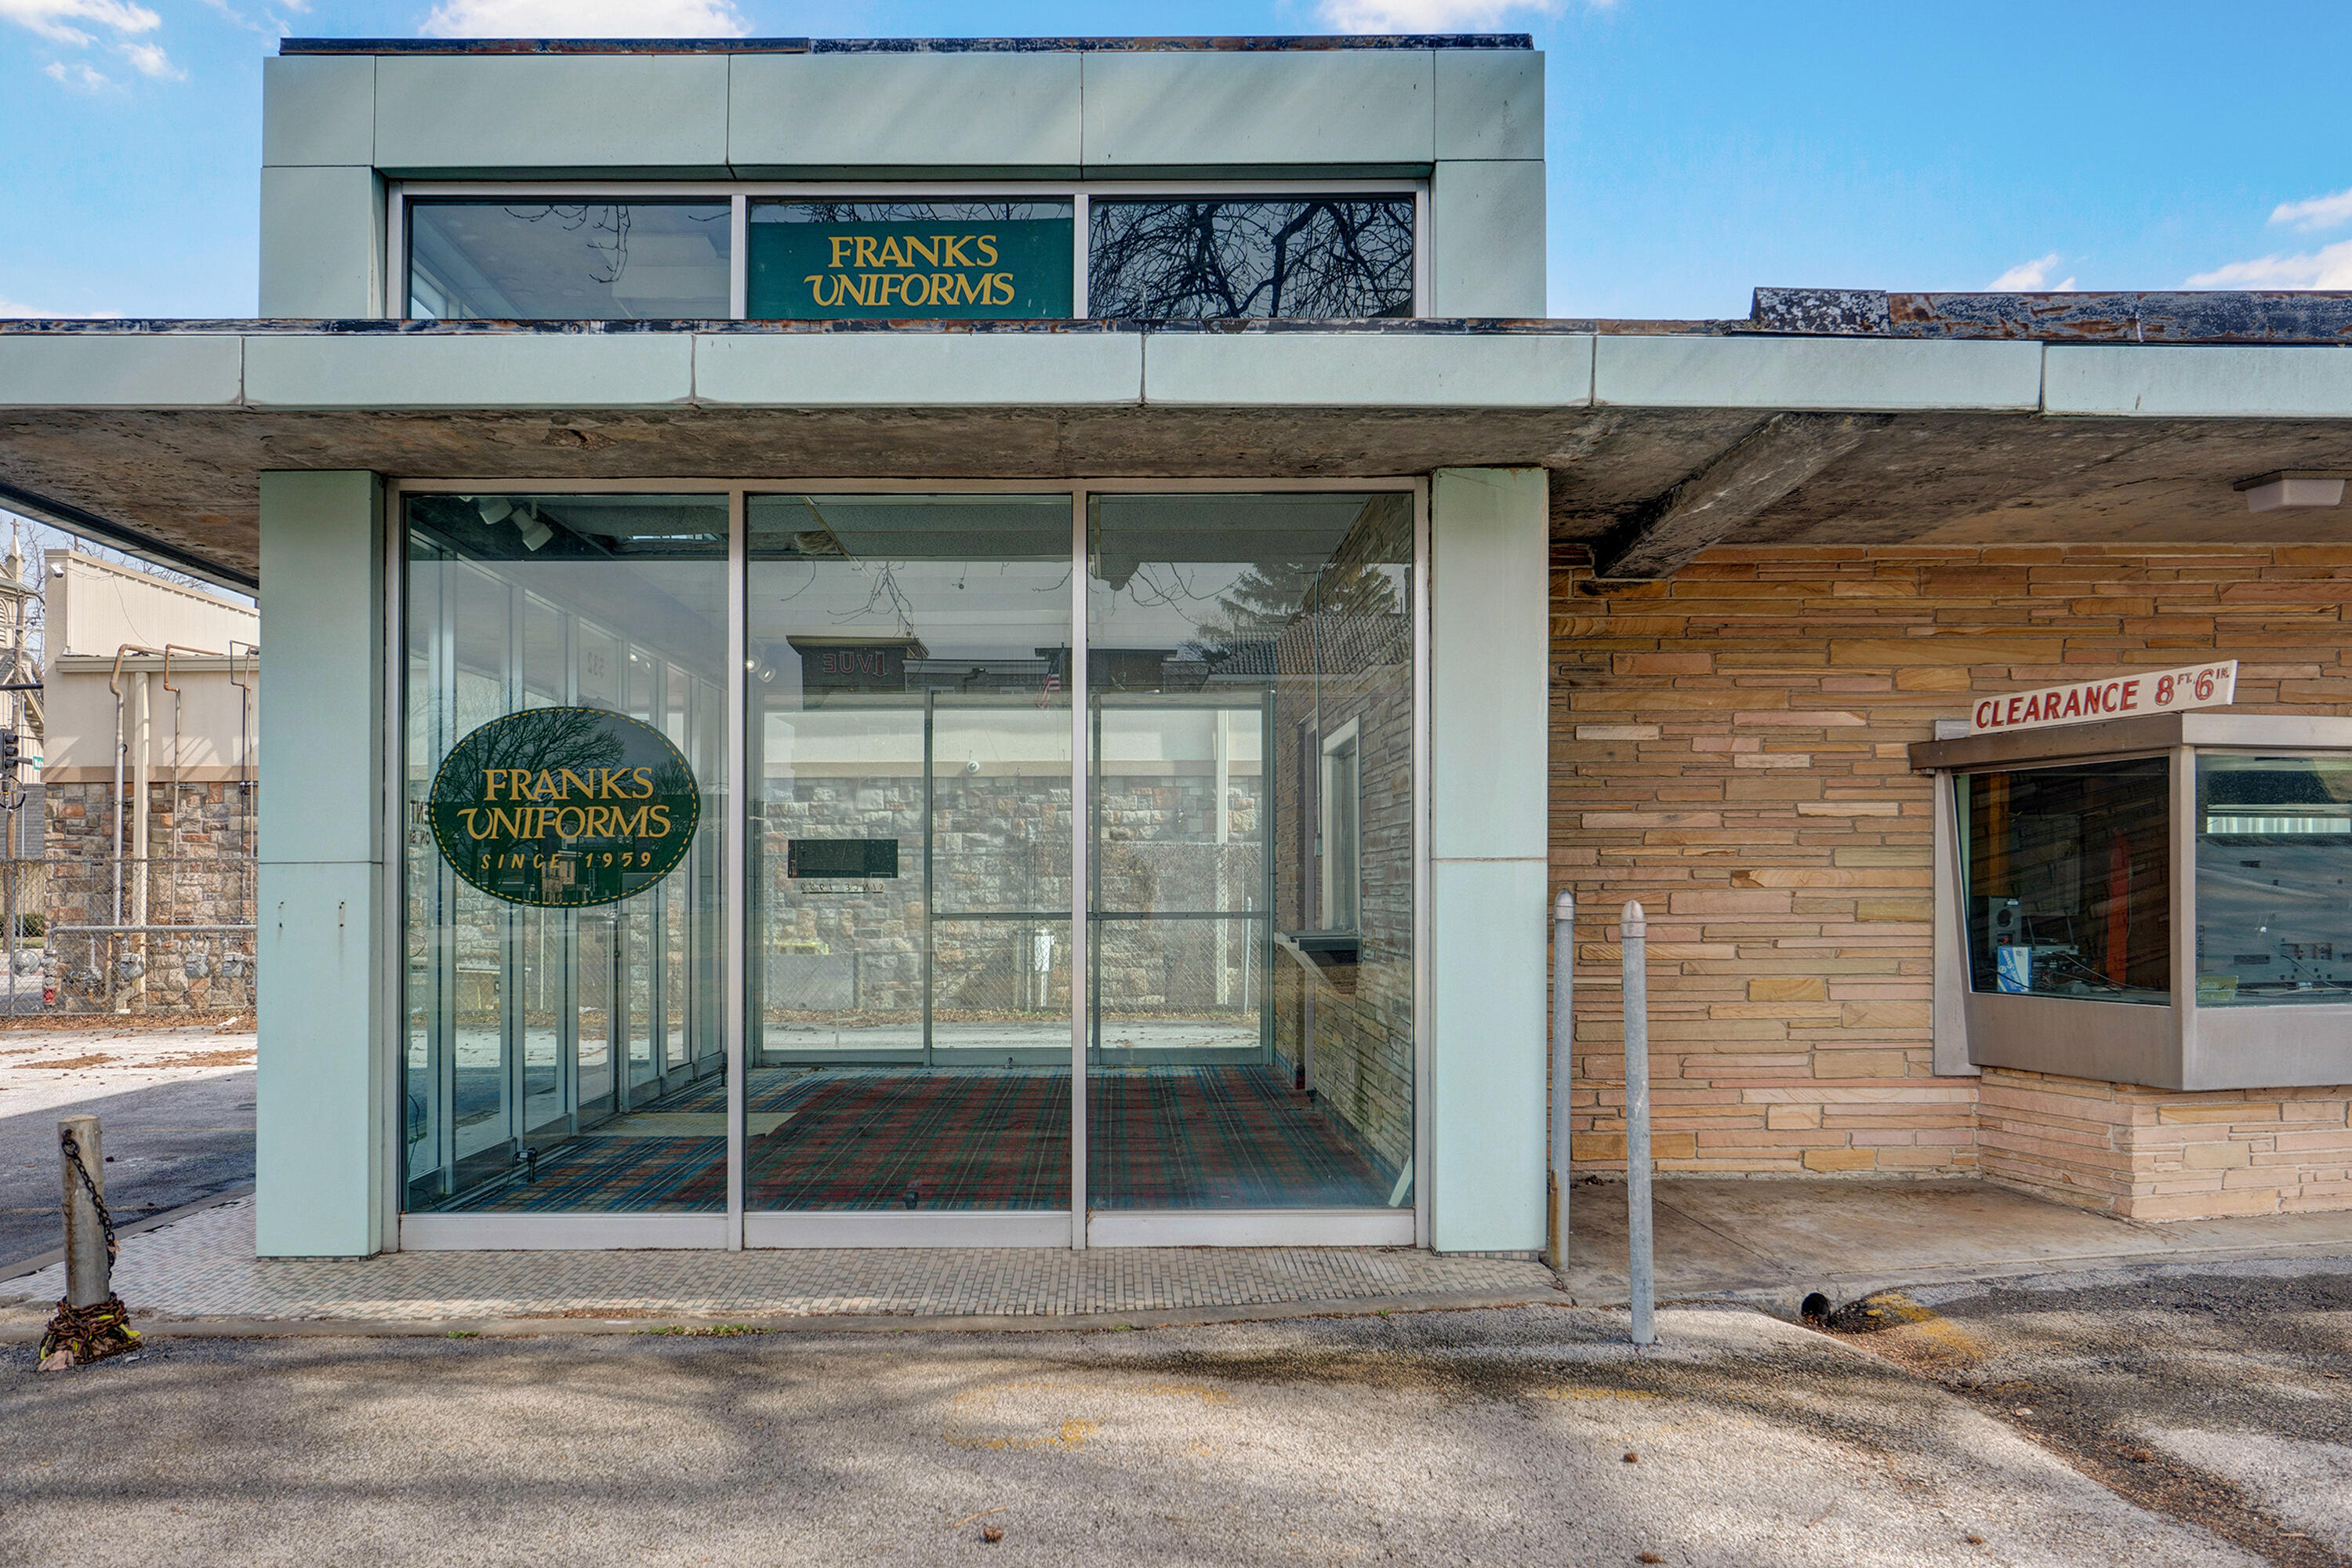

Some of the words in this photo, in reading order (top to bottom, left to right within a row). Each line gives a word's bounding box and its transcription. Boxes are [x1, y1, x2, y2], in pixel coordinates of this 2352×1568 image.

[828, 234, 998, 268] FRANKS
[803, 272, 1015, 307] UNIFORMS
[1976, 679, 2140, 729] CLEARANCE
[482, 767, 654, 801] FRANKS
[456, 804, 672, 840] UNIFORMS
[481, 852, 563, 869] SINCE
[585, 851, 652, 868] 1959
